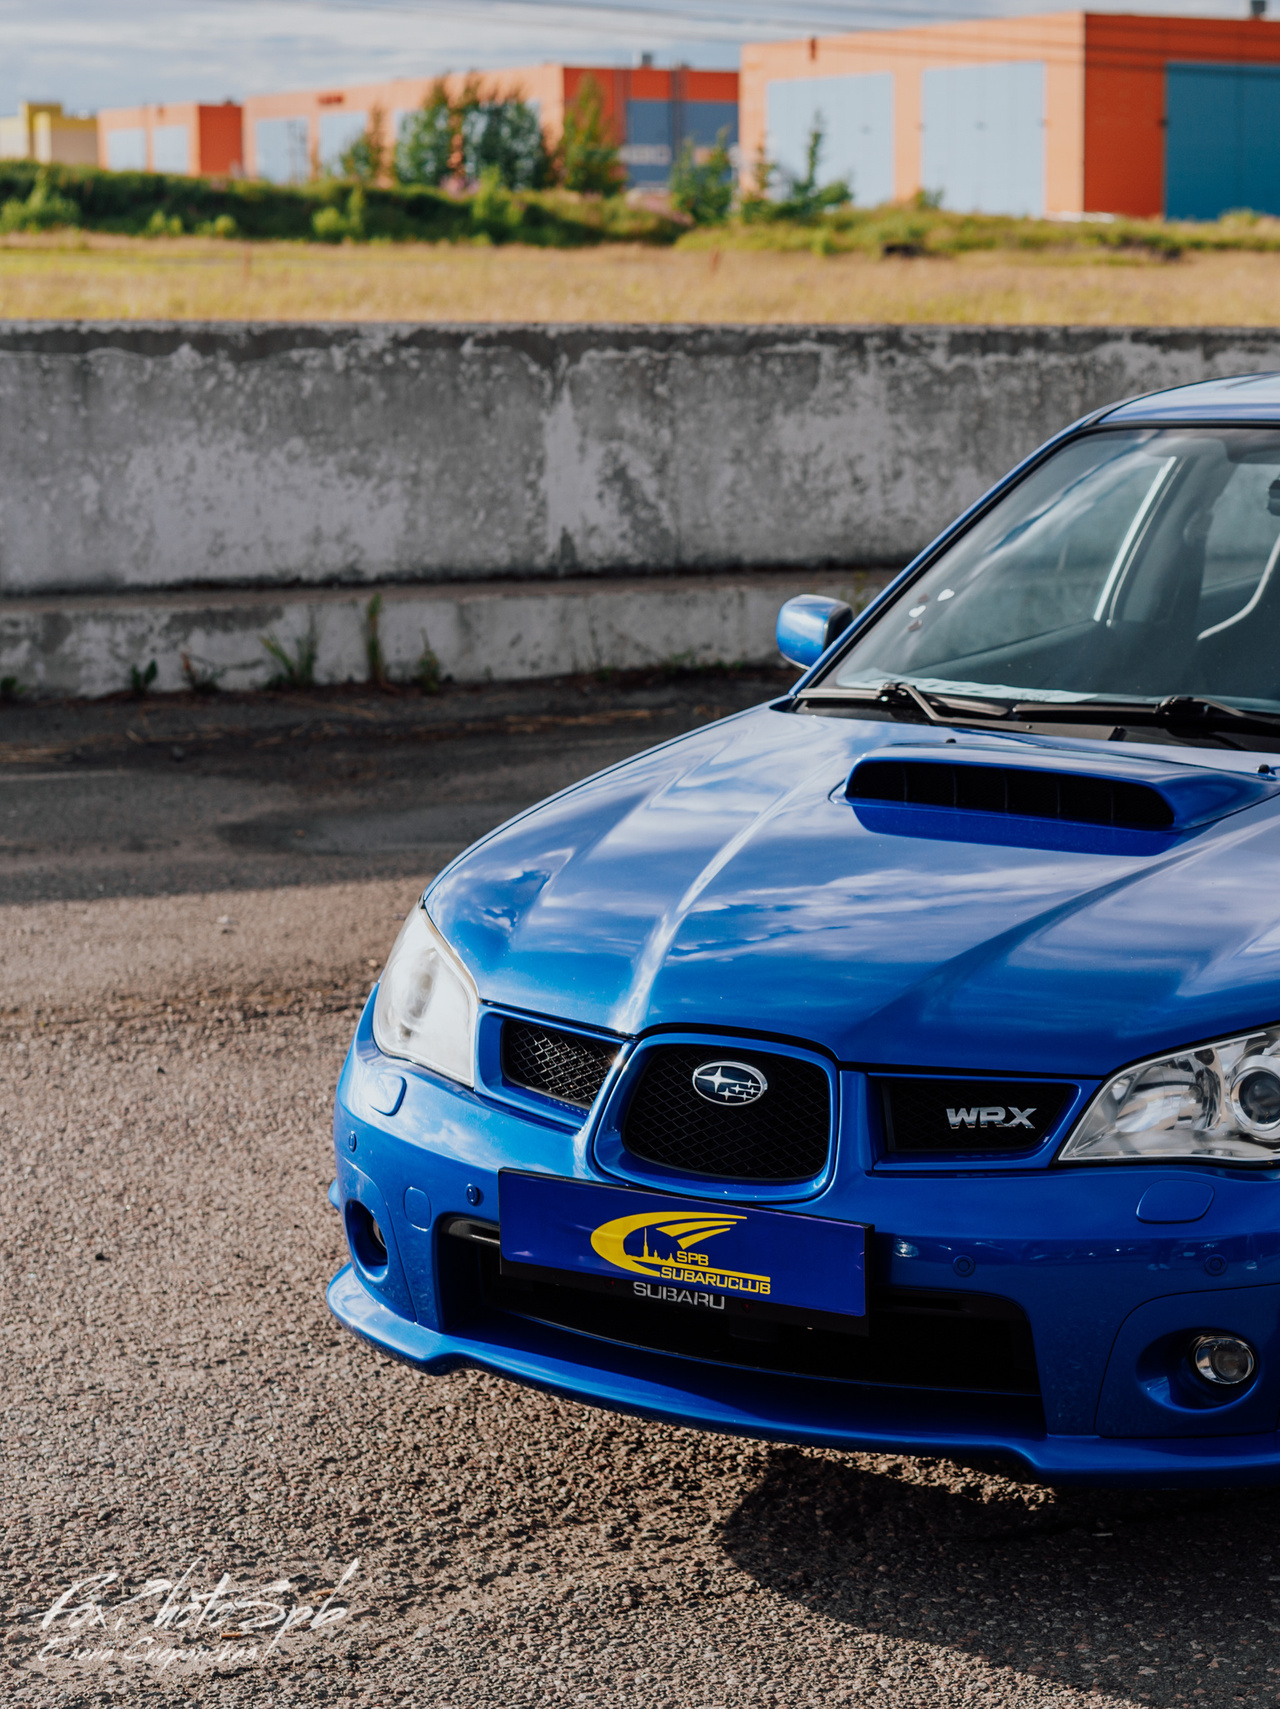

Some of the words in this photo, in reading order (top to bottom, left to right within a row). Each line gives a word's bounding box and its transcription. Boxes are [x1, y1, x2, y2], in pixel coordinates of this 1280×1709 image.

[946, 1106, 1037, 1130] WRX
[676, 1250, 709, 1265] SPB
[661, 1267, 771, 1295] SUBARUCLUB
[633, 1281, 726, 1310] SUBARU
